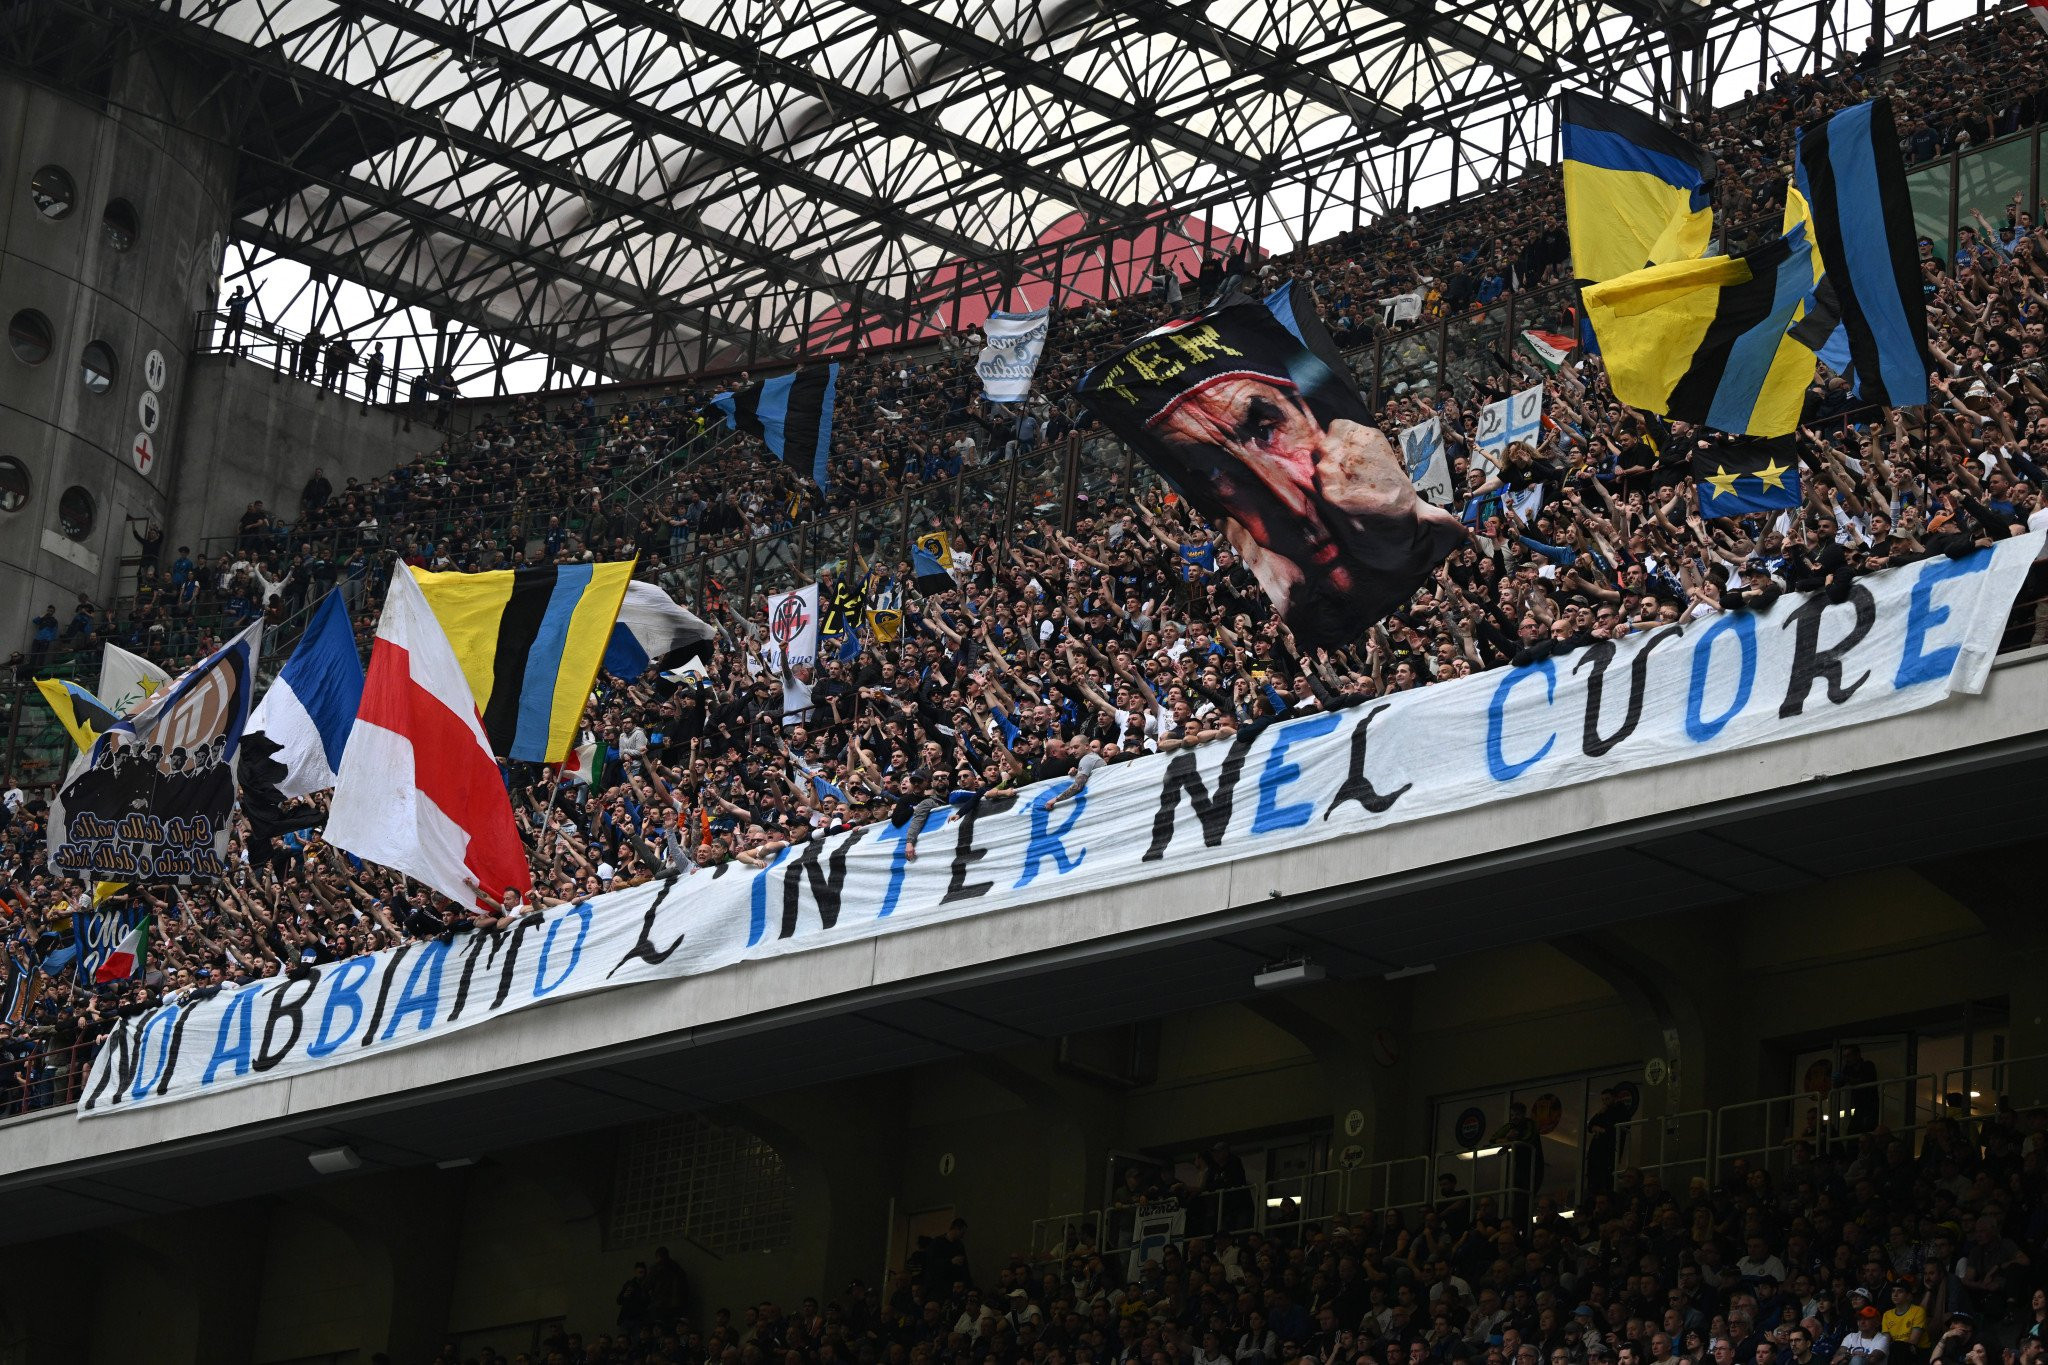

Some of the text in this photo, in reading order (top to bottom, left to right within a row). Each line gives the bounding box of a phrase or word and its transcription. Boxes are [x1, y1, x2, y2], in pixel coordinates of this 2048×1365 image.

[85, 1001, 199, 1110] NOI
[201, 901, 593, 1086] ABBIAMO
[1142, 703, 1412, 862] NEL
[1486, 545, 1998, 783] CUORE
